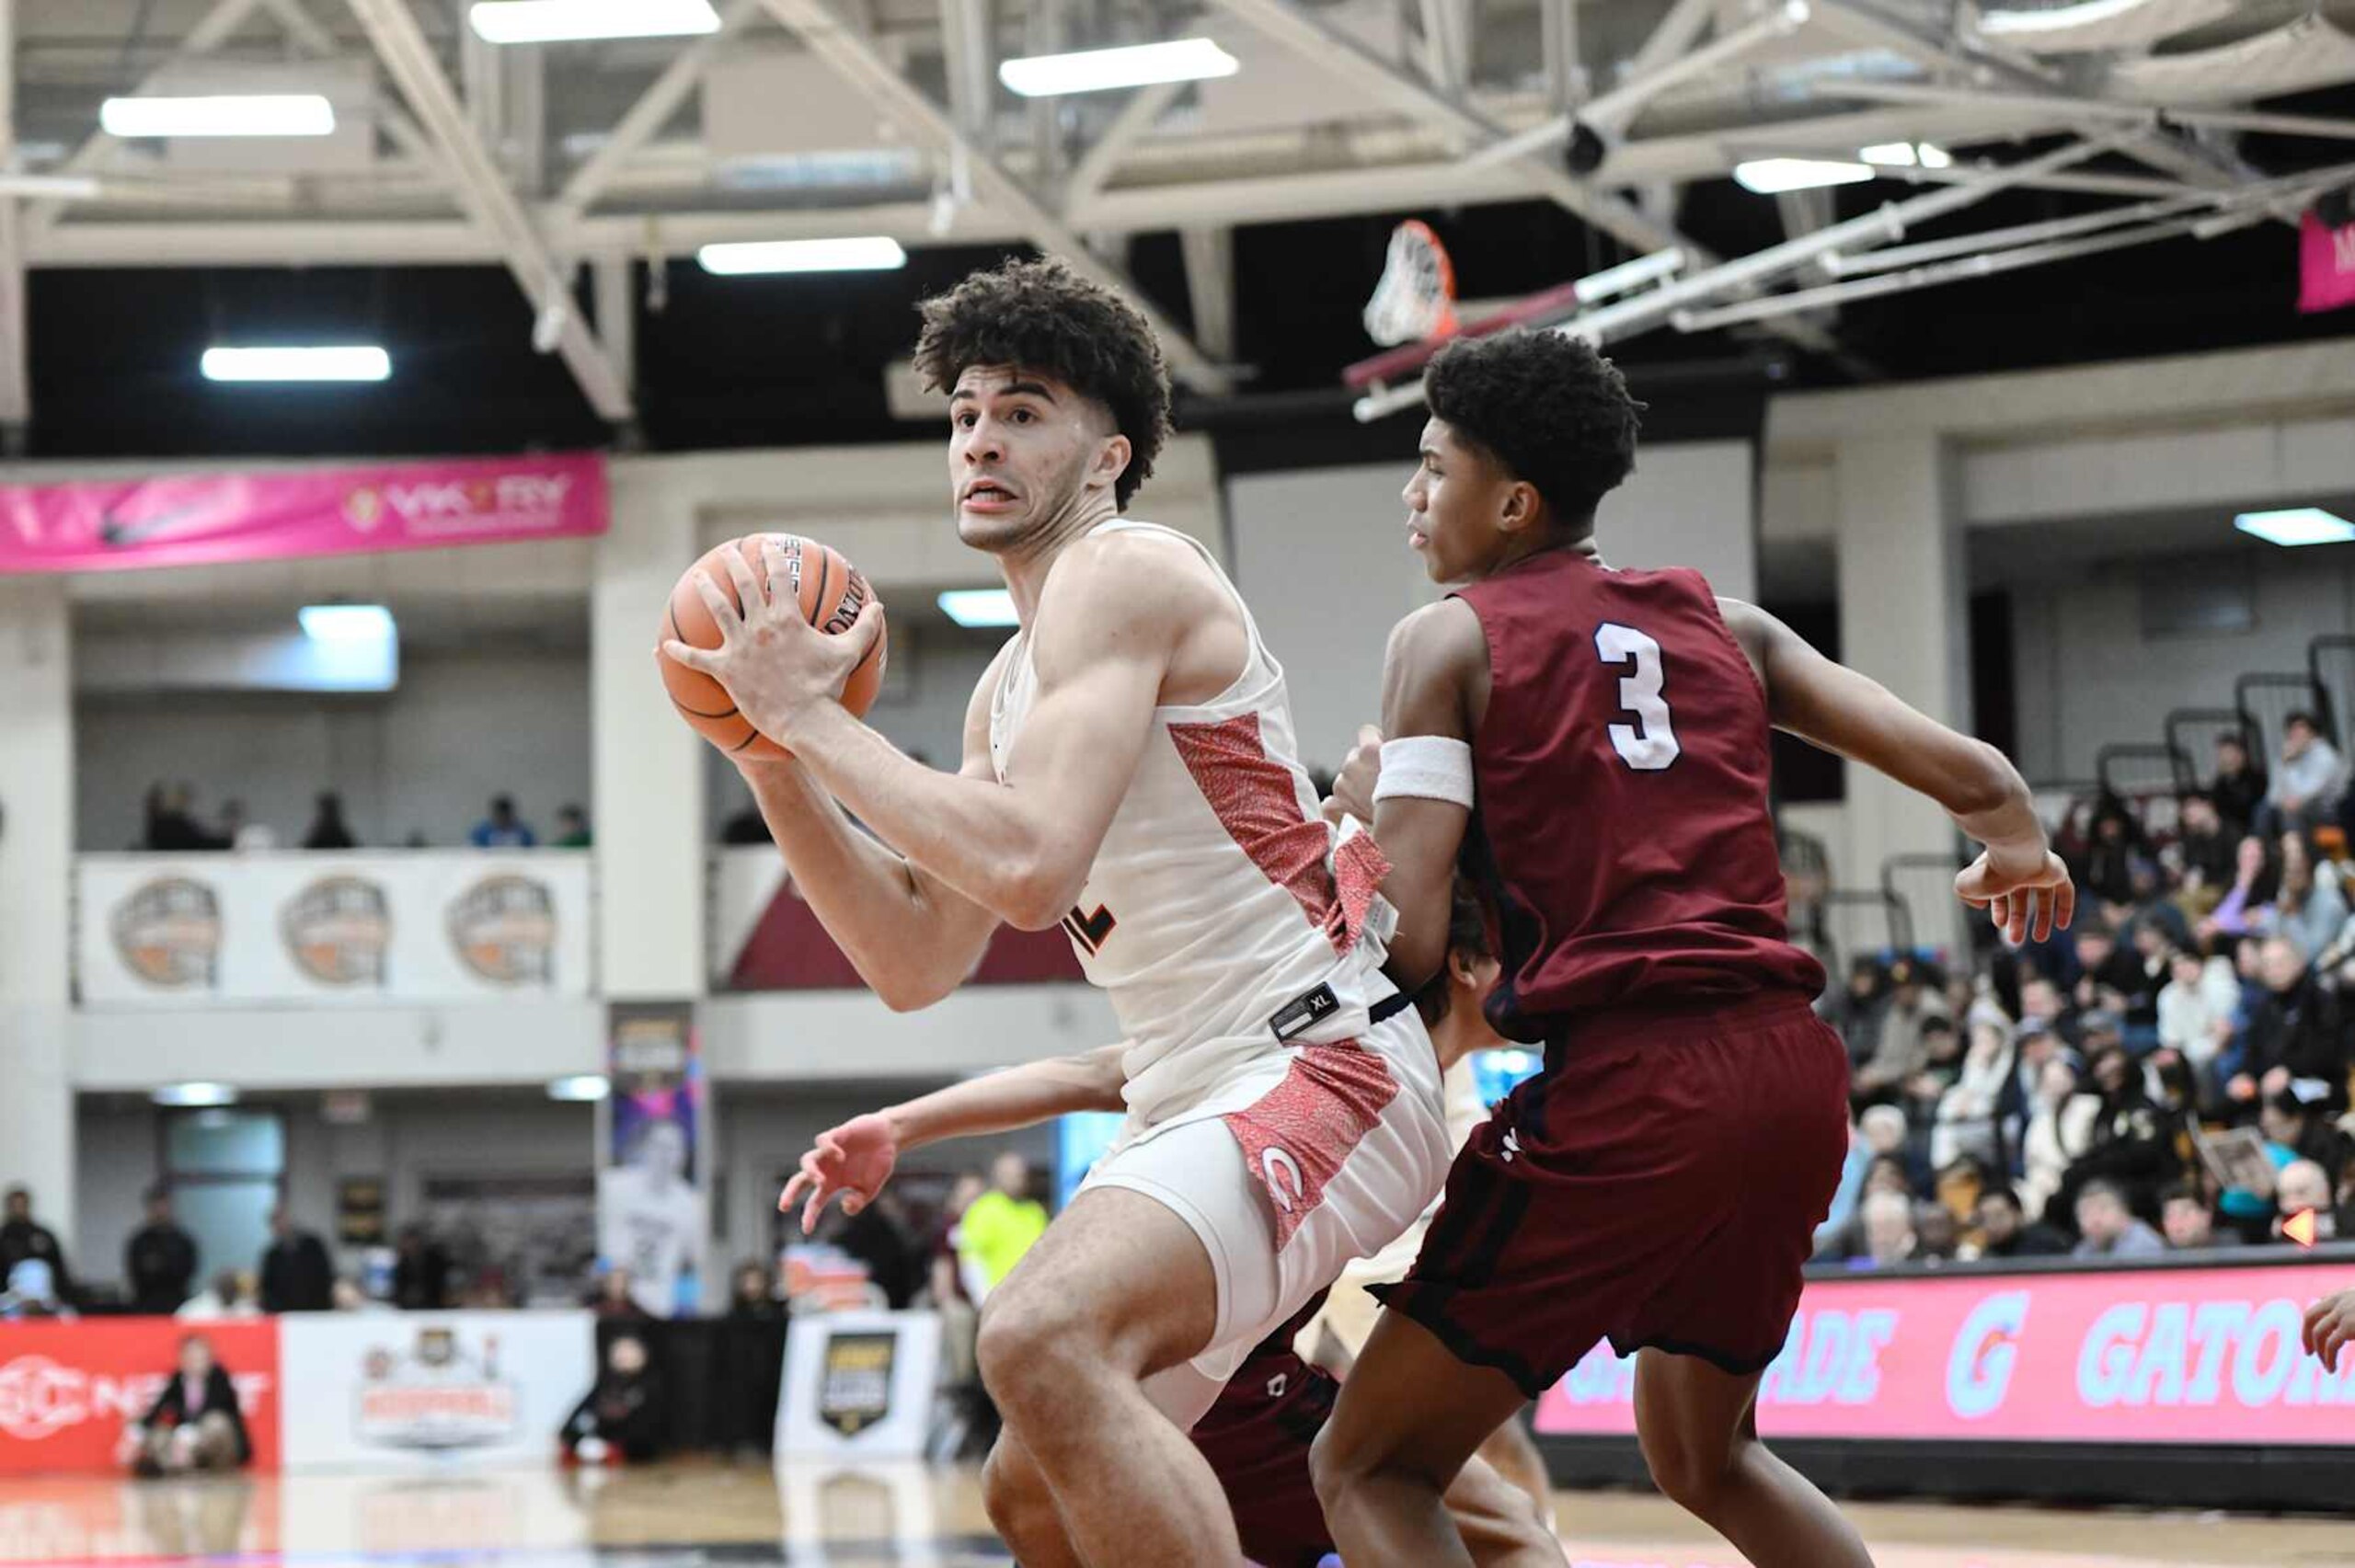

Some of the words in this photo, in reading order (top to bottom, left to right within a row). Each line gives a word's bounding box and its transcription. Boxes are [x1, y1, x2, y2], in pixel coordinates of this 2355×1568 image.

[1593, 622, 1682, 771] 3
[1310, 994, 1332, 1012] XL
[1945, 1290, 2031, 1419] G
